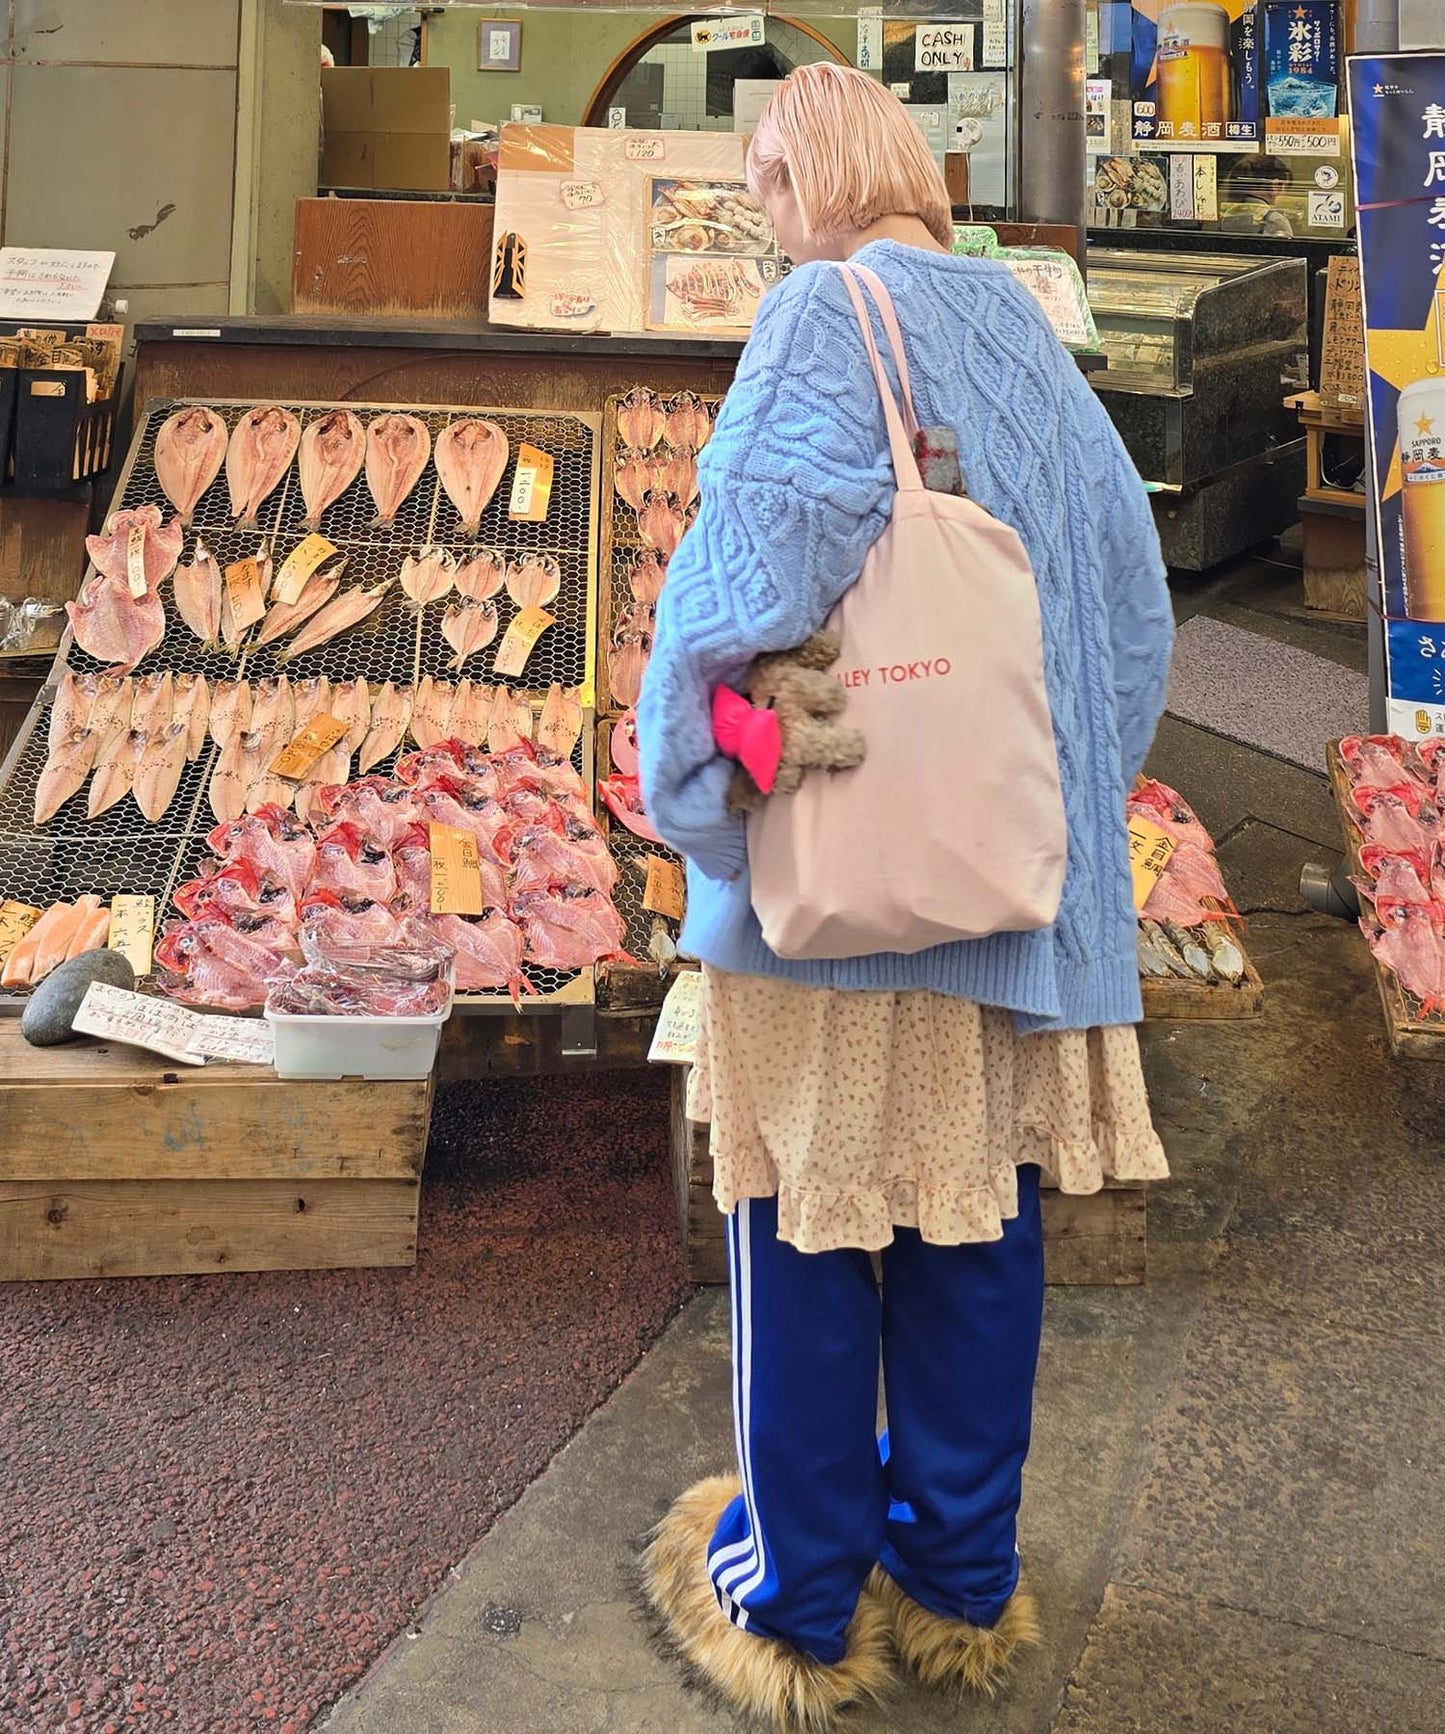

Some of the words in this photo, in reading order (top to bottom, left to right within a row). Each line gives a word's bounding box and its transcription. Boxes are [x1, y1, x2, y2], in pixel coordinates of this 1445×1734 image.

[921, 31, 963, 47] CASH
[1288, 21, 1312, 62] 氷彩
[921, 51, 963, 66] ONLY
[1136, 103, 1154, 115] 600
[1134, 121, 1222, 137] 静岡麦酒
[1313, 213, 1340, 222] ATAMI
[1411, 437, 1441, 448] SAPPORO
[838, 668, 870, 688] LEY
[879, 658, 951, 684] TOKYO
[1141, 837, 1174, 878] 金目鯛
